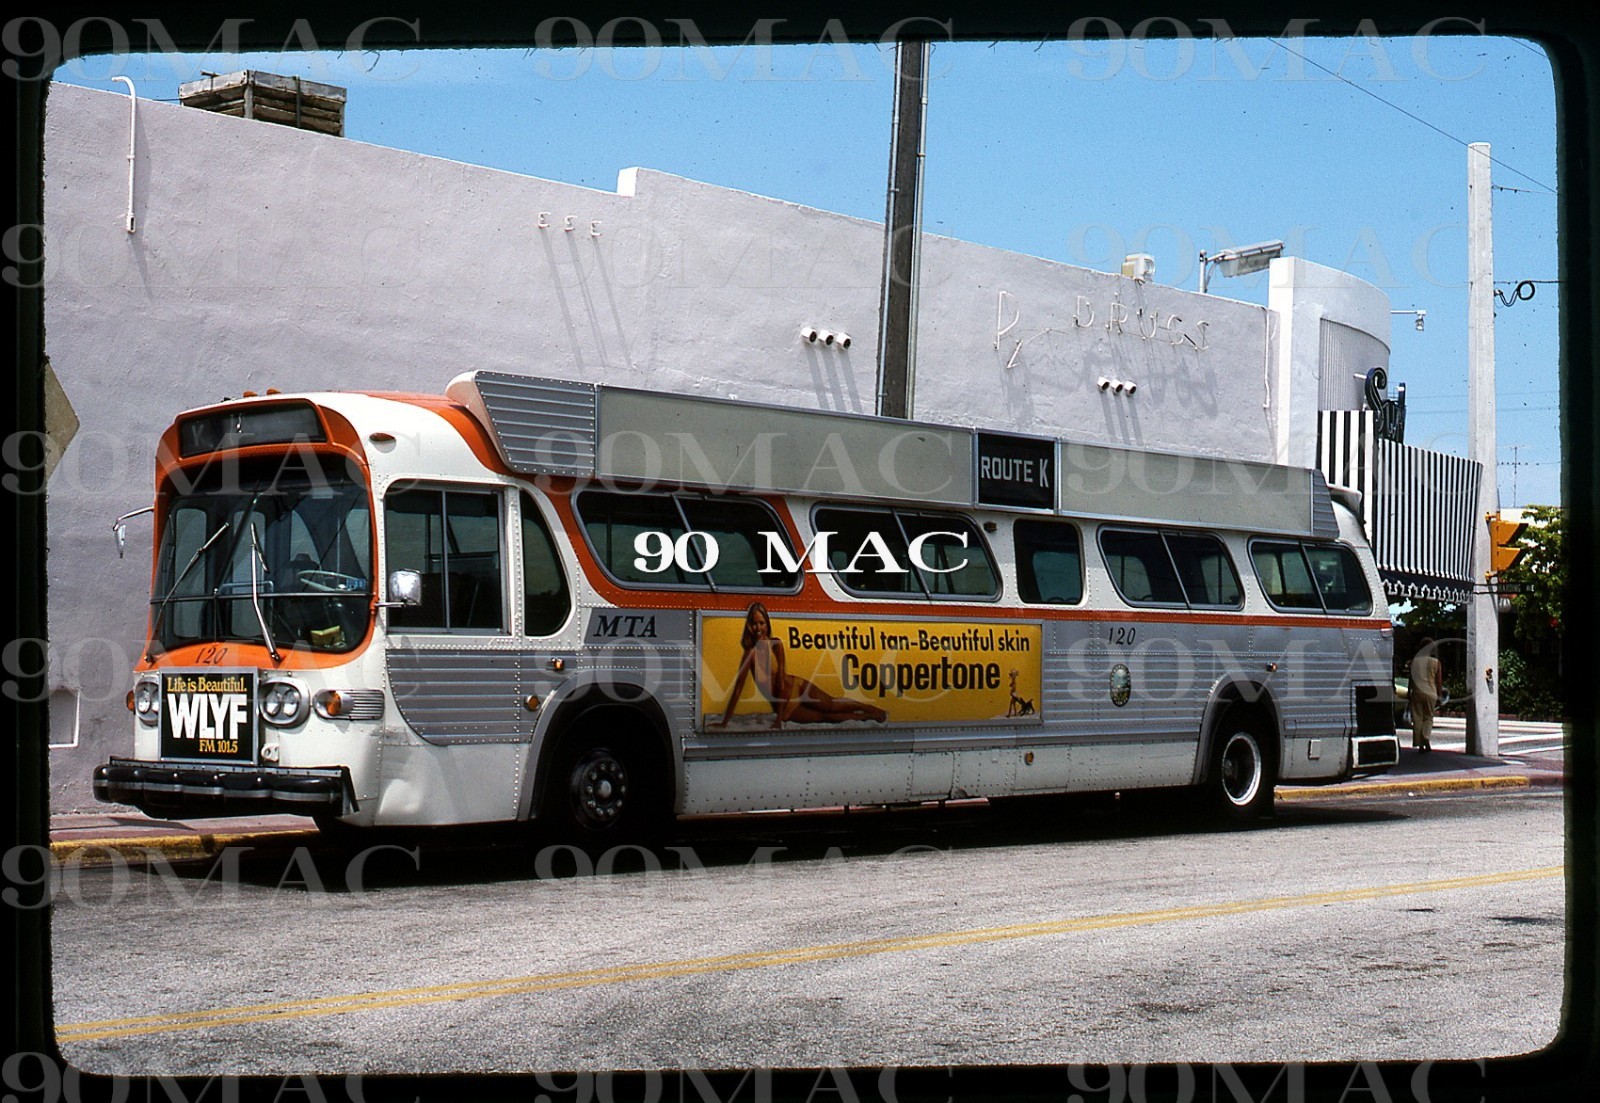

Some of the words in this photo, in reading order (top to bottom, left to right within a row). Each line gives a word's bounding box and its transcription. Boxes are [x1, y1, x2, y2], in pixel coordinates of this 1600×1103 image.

[981, 456, 1034, 483] ROUTE
[1039, 458, 1049, 488] K
[594, 614, 658, 638] MTA
[1108, 627, 1136, 645] 120
[788, 626, 875, 651] Beautiful
[998, 629, 1030, 652] skin
[195, 646, 228, 664] 120
[167, 677, 187, 692] Life
[188, 678, 196, 692] is
[197, 677, 248, 692] Beautiful.
[841, 653, 1001, 698] Coppertone
[166, 693, 248, 740] WLYF
[199, 740, 216, 753] FM
